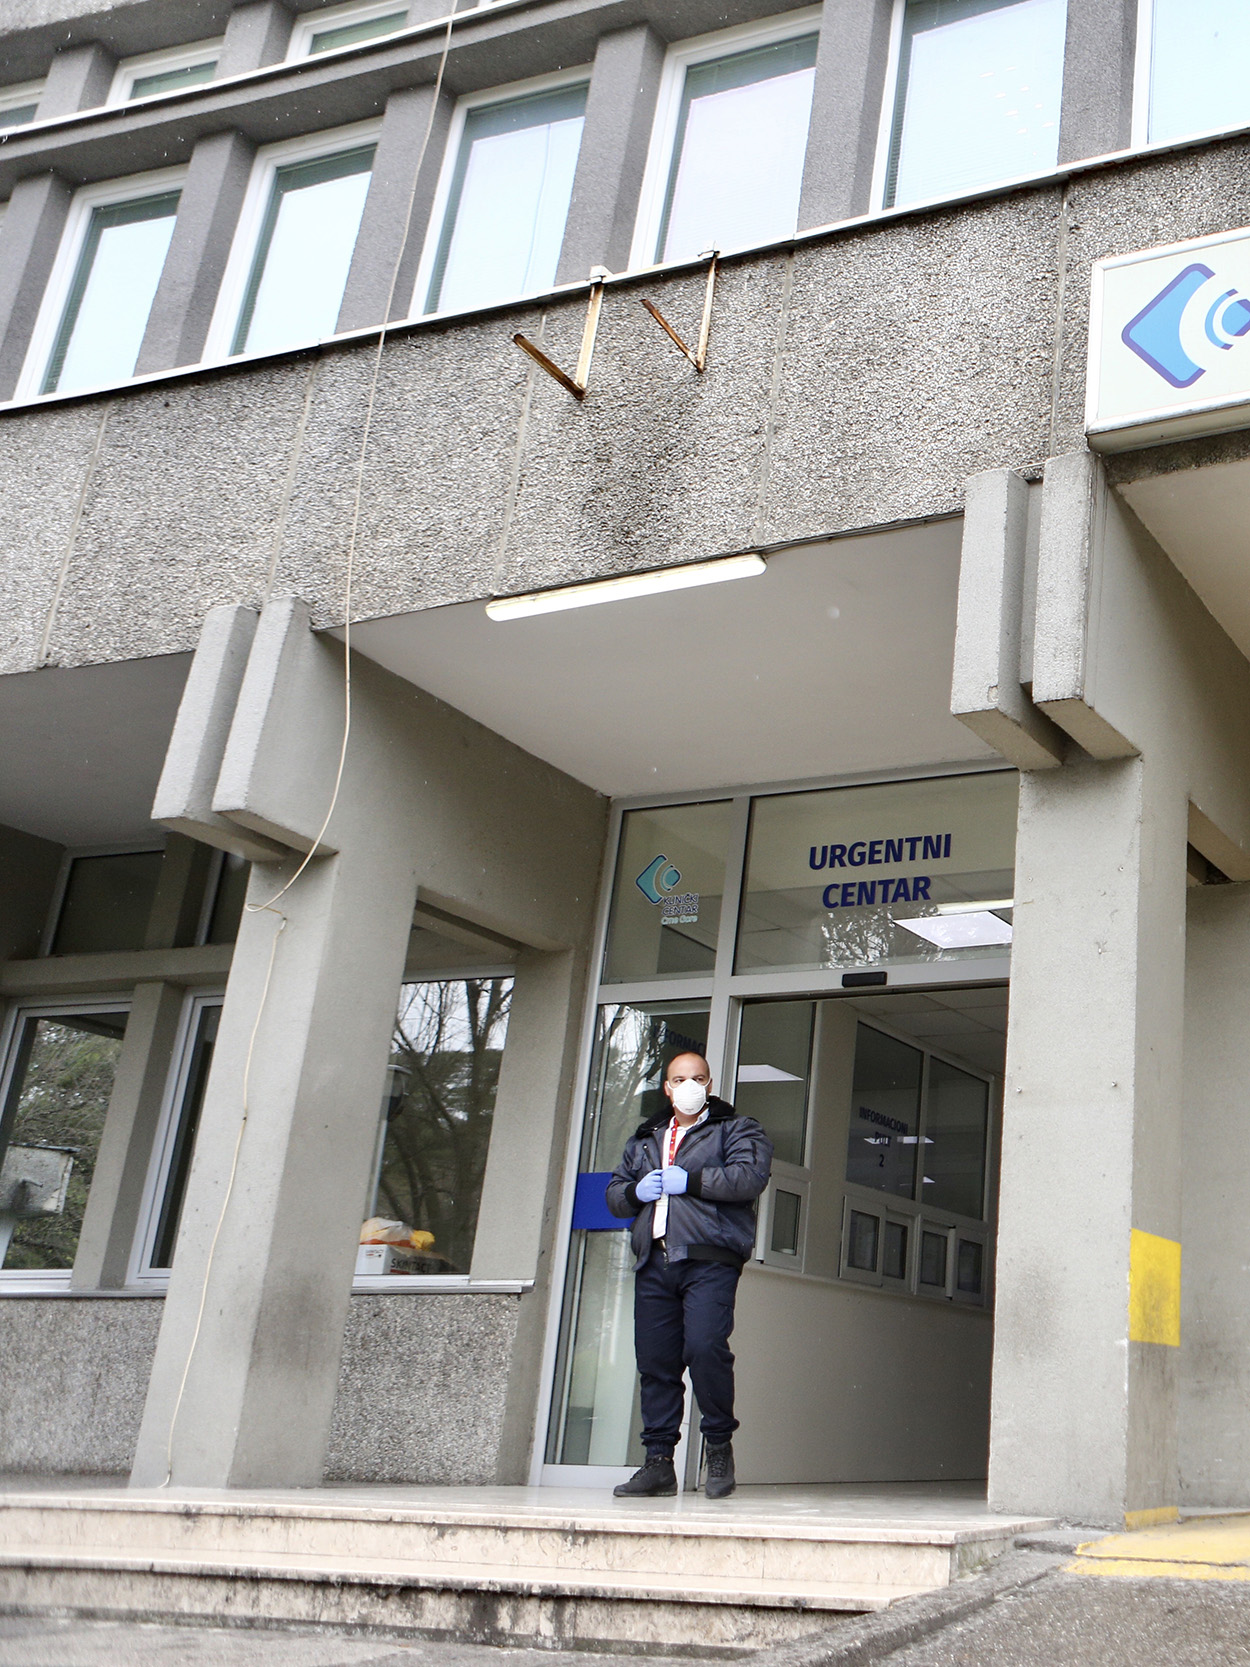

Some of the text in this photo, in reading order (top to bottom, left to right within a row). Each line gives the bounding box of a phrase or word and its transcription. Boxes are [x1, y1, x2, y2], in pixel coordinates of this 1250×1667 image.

[809, 833, 952, 870] URGENTNI
[822, 876, 931, 909] CENTAR
[662, 904, 698, 916] CENTAR
[879, 1153, 885, 1168] 2
